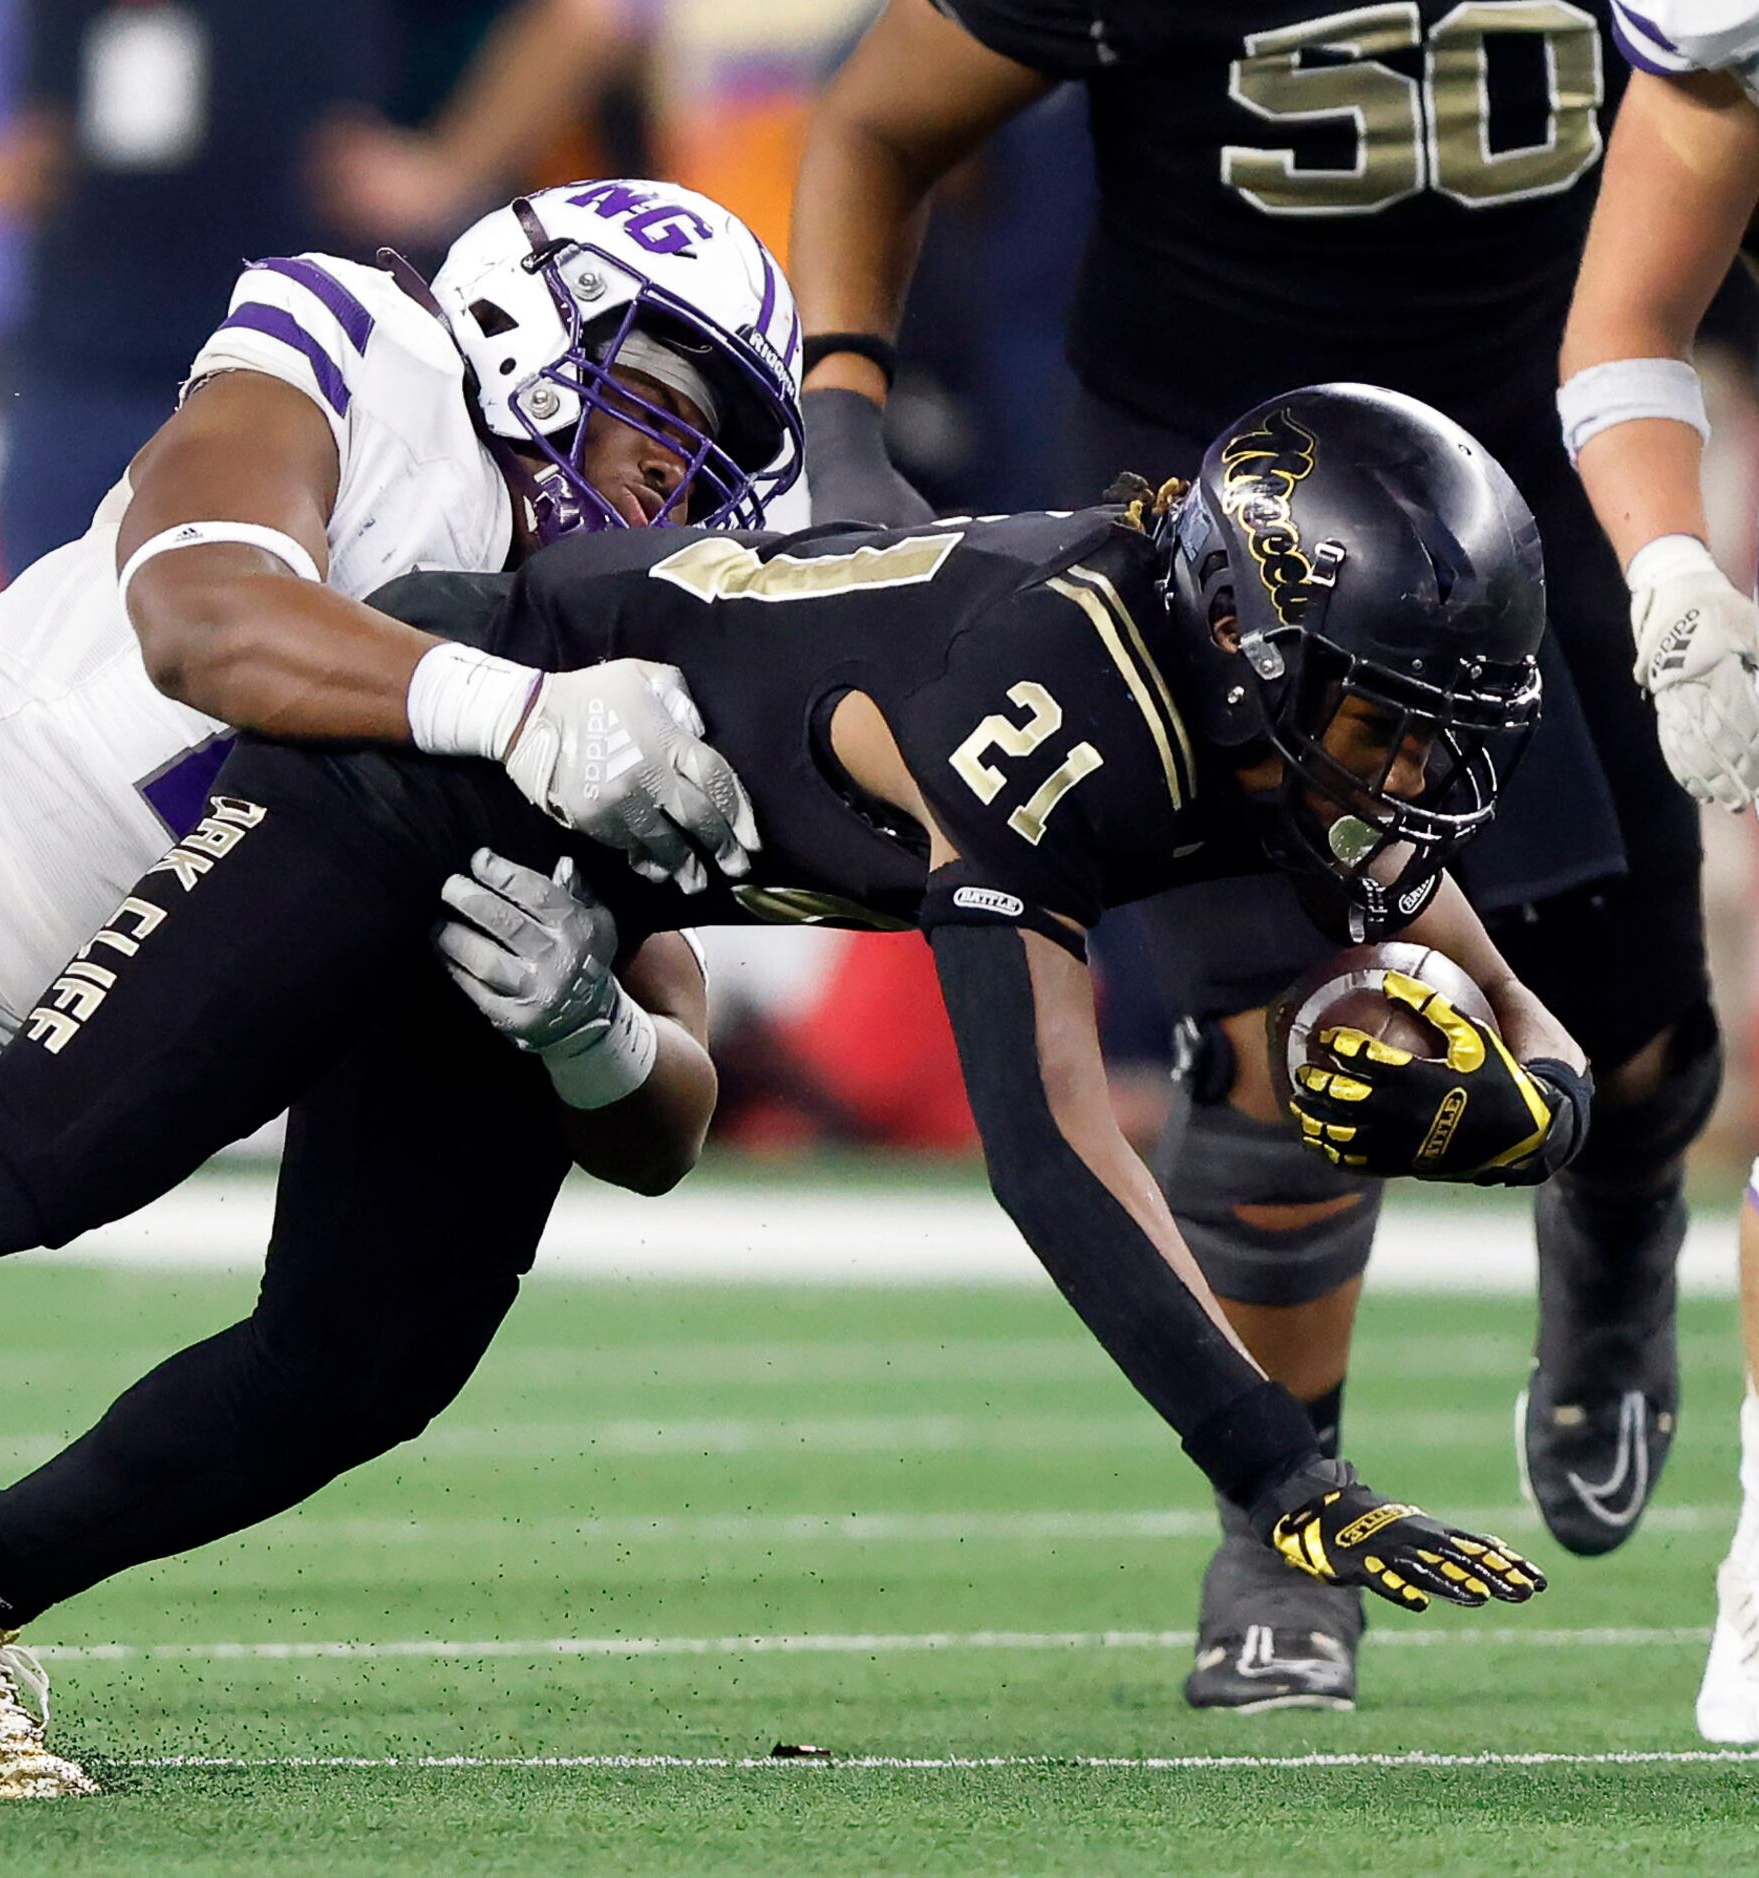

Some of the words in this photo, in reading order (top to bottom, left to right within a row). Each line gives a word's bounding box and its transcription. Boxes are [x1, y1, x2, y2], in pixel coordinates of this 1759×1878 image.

[1220, 0, 1604, 216] 50
[583, 698, 605, 801] adidas
[948, 680, 1105, 847] 21
[26, 896, 169, 1055] CLIFF
[959, 888, 1019, 913] BATTLE
